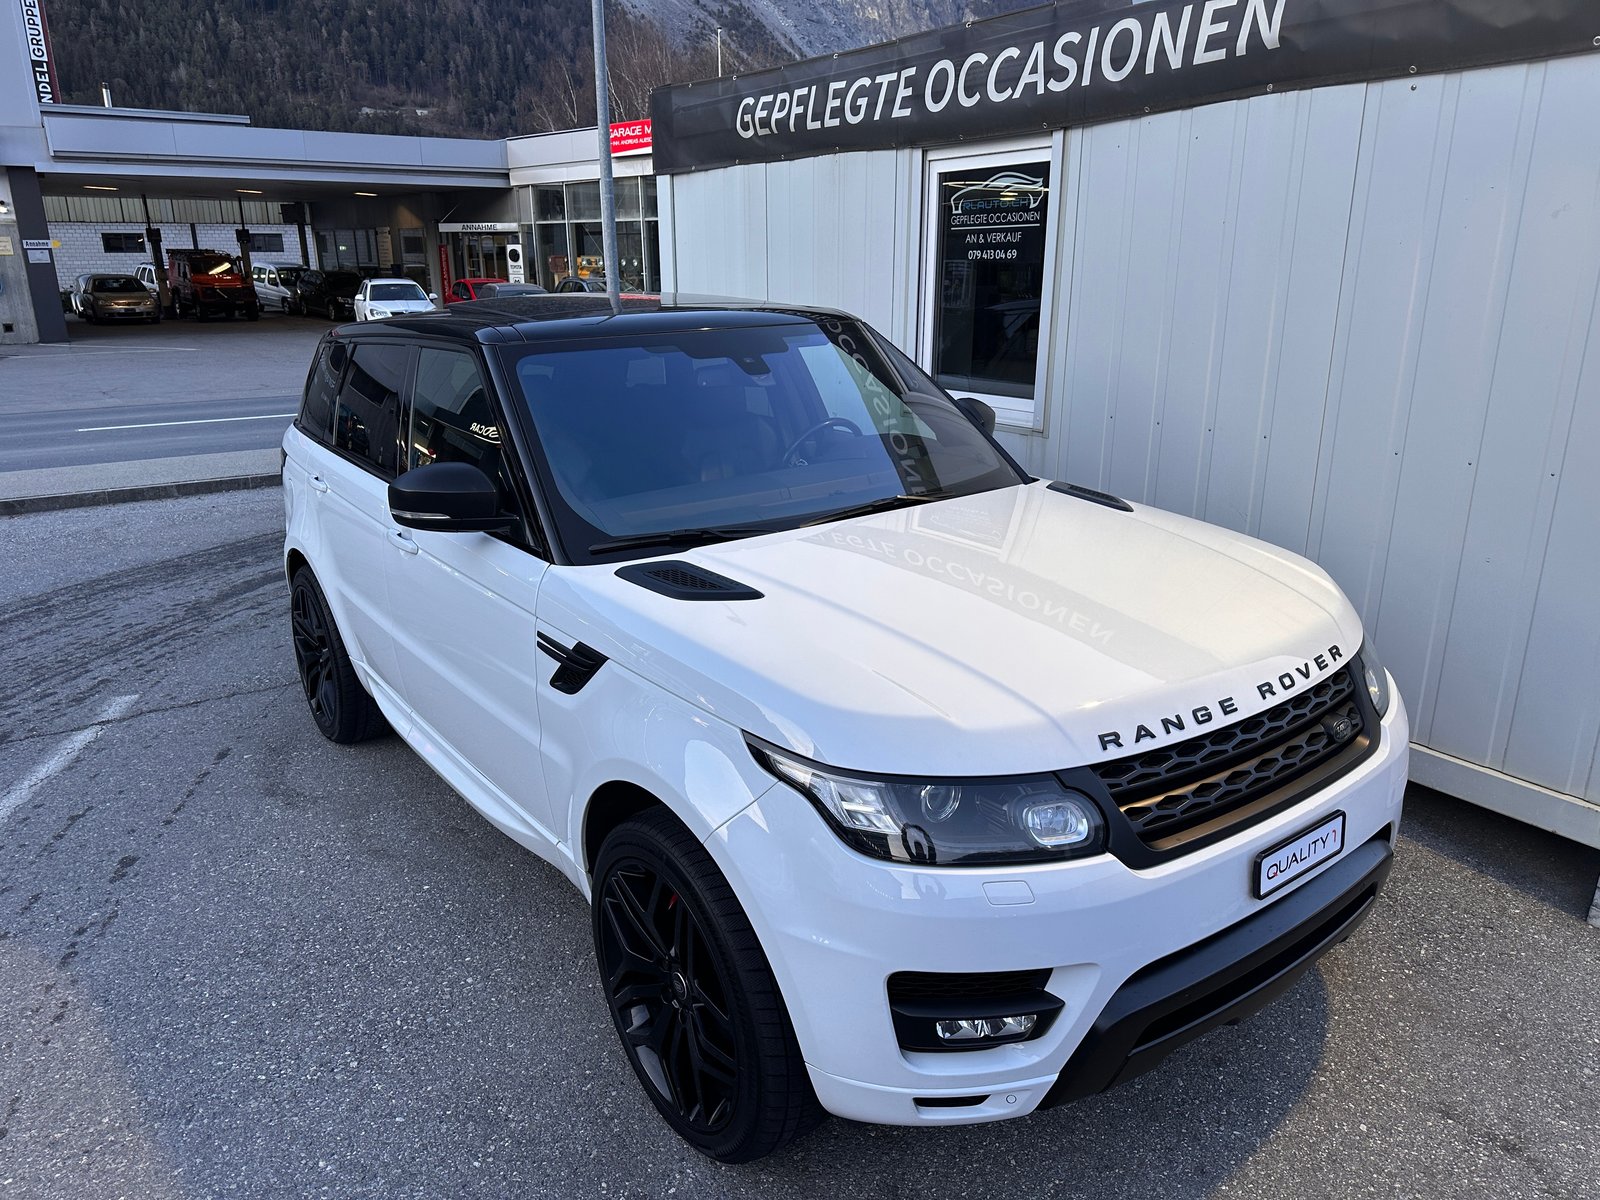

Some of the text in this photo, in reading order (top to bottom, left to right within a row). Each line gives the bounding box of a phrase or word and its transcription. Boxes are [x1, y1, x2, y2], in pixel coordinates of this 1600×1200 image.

[24, 0, 45, 58] GRUPPE
[736, 0, 1286, 139] GEPFLEGTE OCCASIONEN
[950, 211, 1040, 225] GEPFLEGTE OCCASIONEN
[965, 232, 1022, 243] AN & VERKAUF
[968, 249, 1017, 260] 079 413 04 69
[1098, 644, 1344, 751] RANGE ROVER
